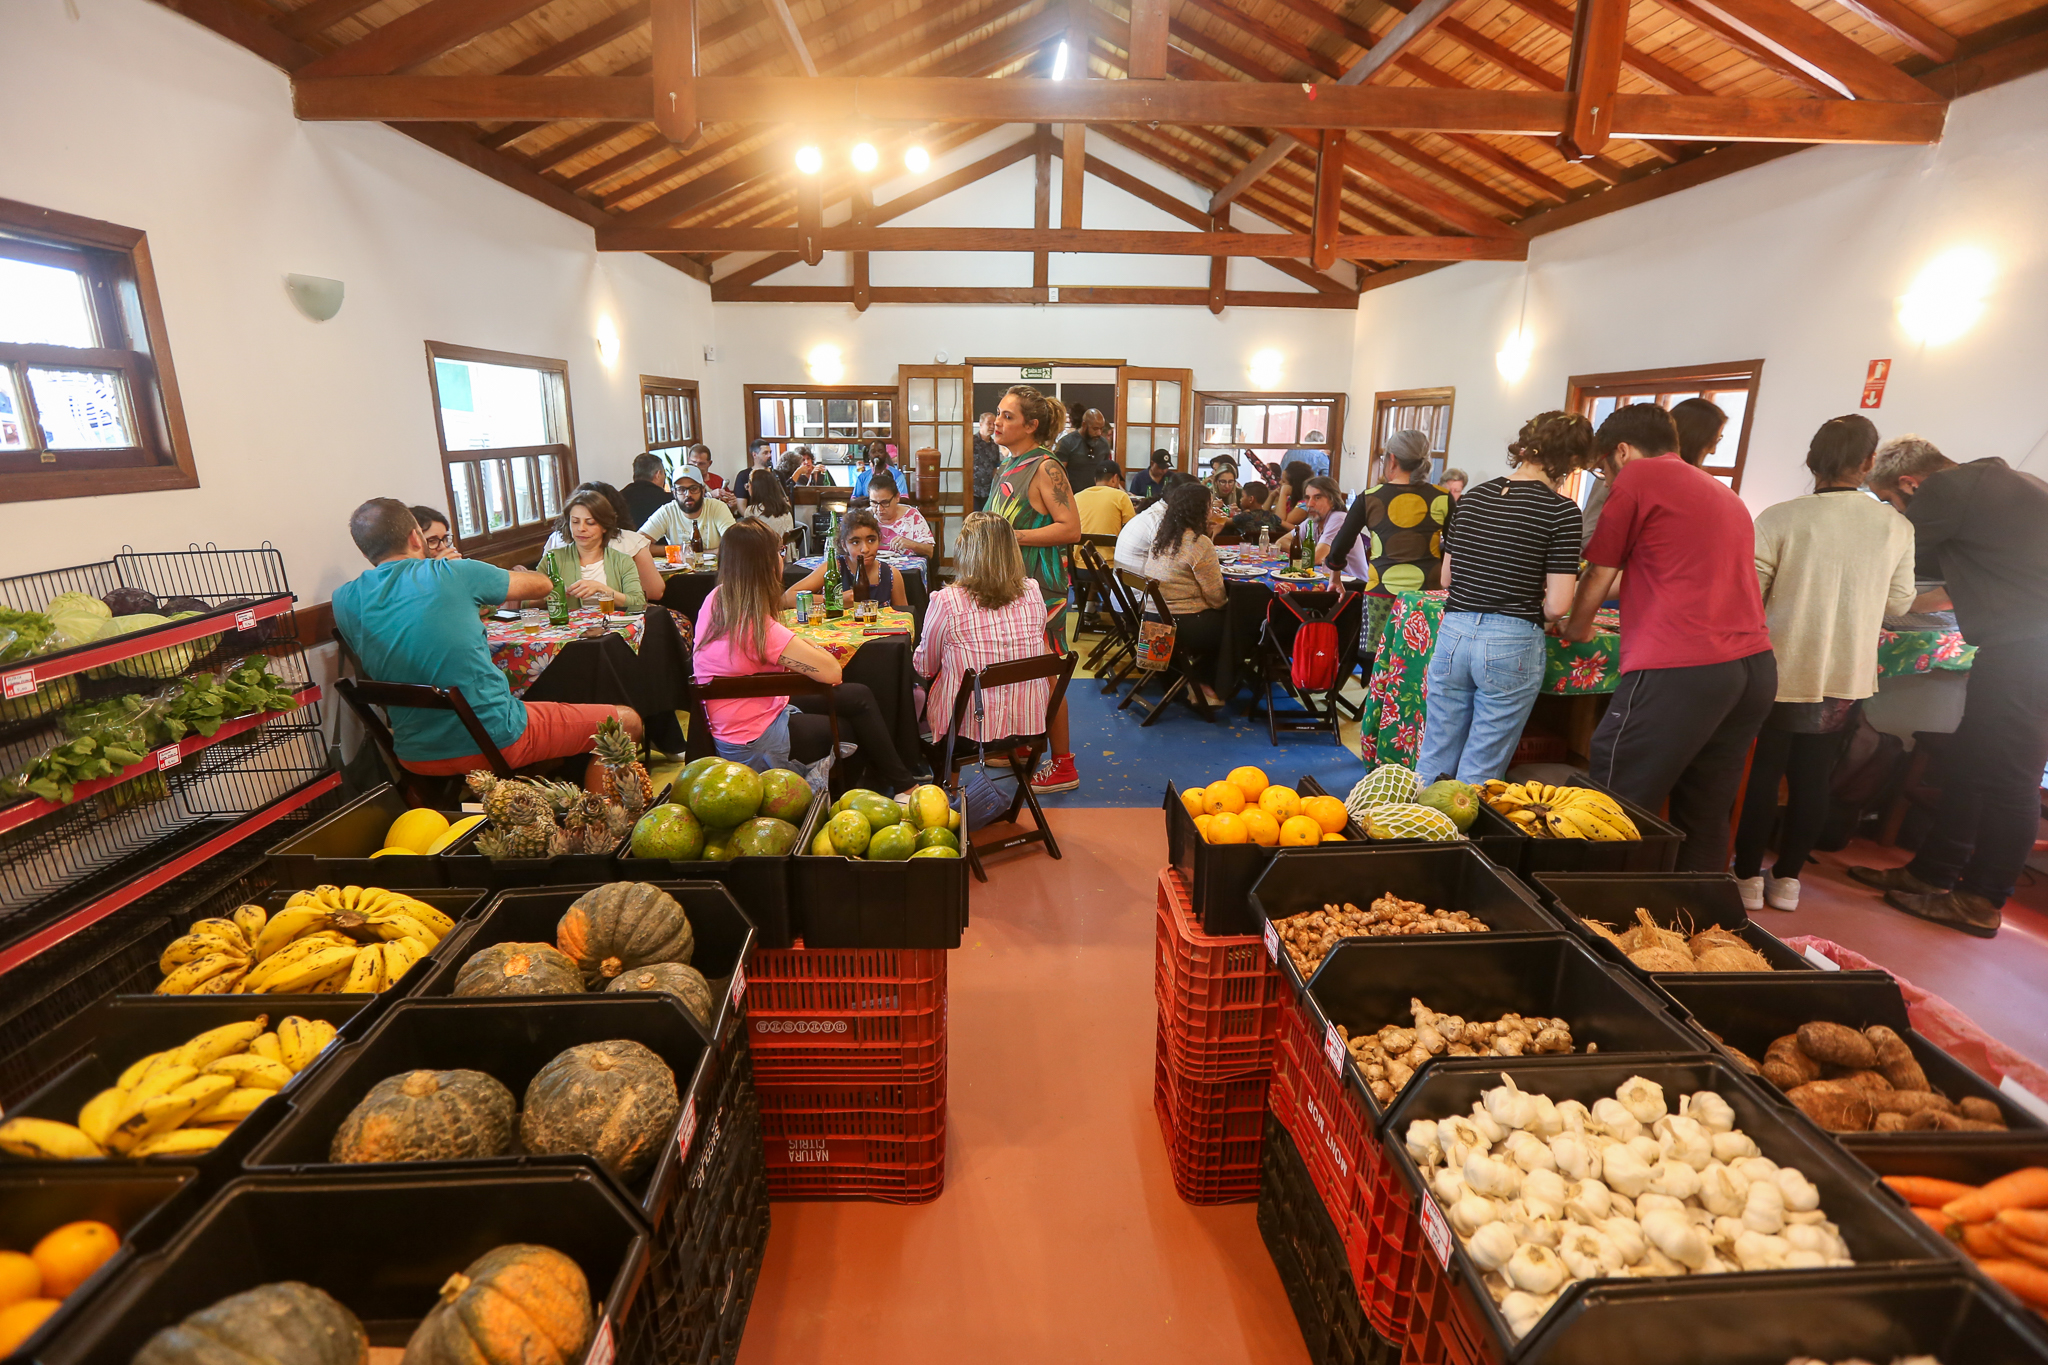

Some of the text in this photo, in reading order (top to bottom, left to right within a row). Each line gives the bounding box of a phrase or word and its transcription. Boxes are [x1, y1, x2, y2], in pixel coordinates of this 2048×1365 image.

[756, 1021, 848, 1034] BATISTA
[1307, 1095, 1348, 1177] MONT MOR
[788, 1139, 825, 1150] CITRUS
[788, 1150, 829, 1163] NATURA
